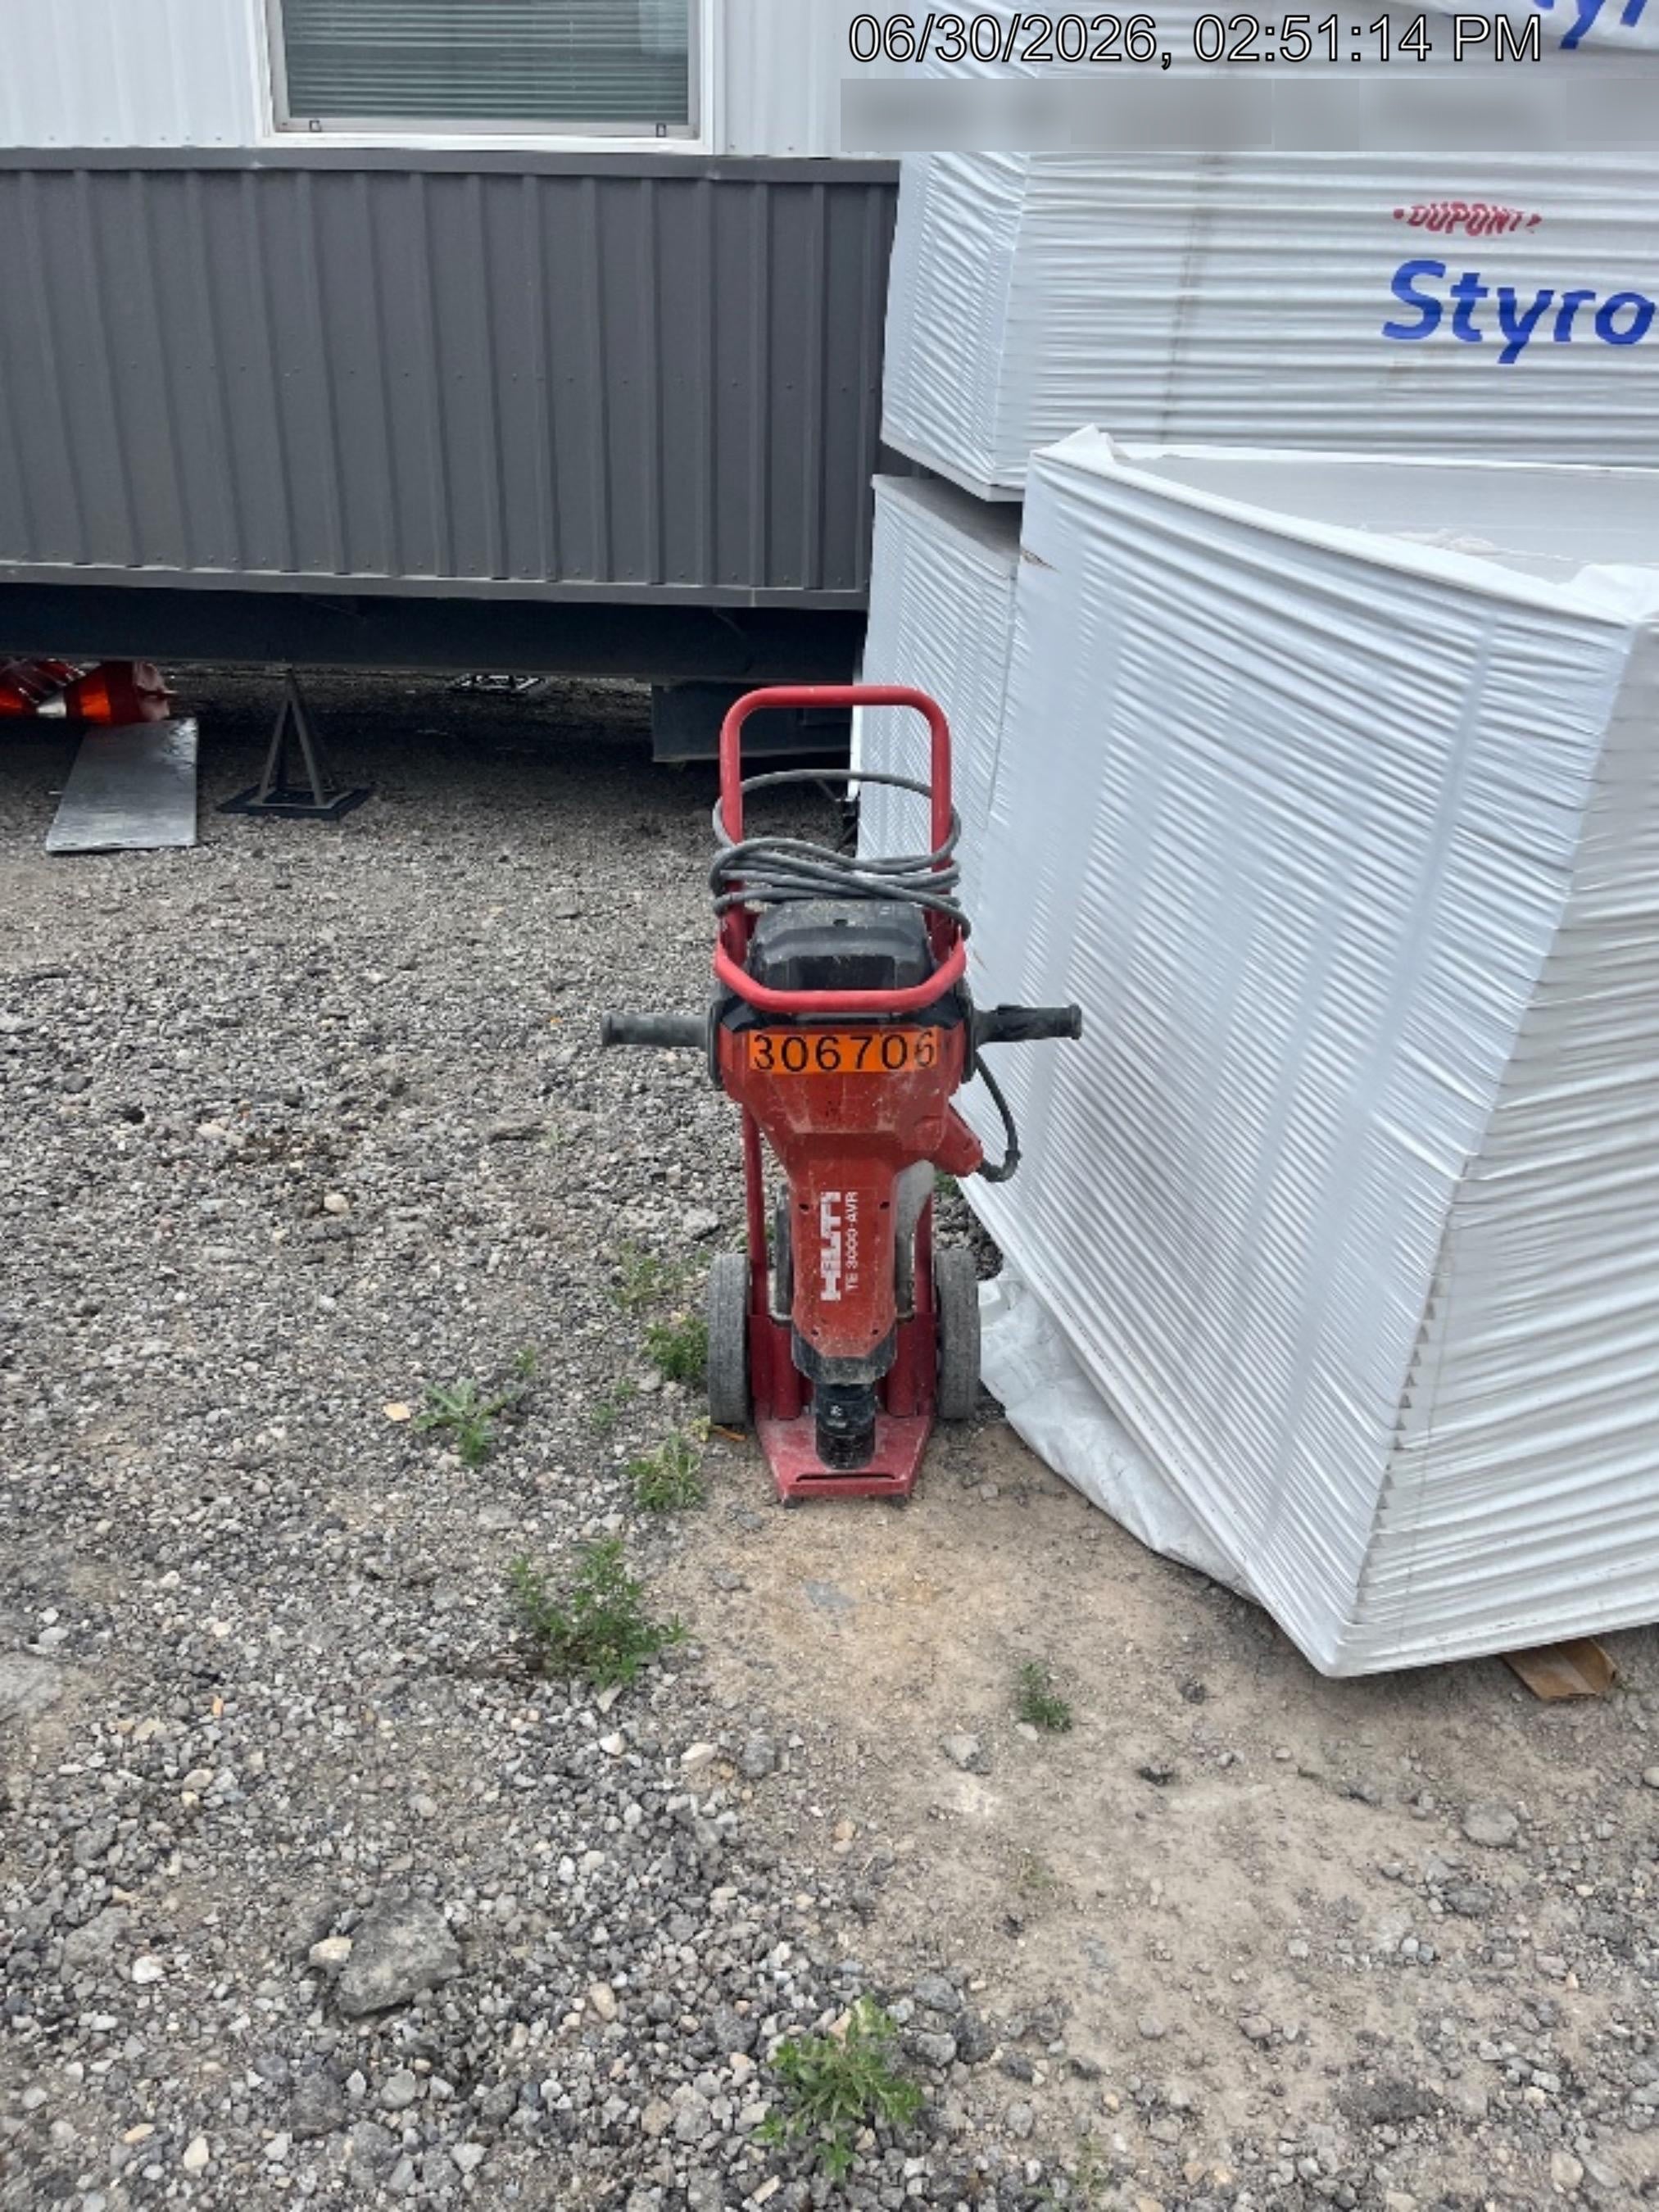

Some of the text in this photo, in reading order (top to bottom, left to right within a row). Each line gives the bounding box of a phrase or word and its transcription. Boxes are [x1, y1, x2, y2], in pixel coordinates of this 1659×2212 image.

[1382, 260, 1657, 364] Styro
[754, 1028, 935, 1072] 306706
[820, 1191, 841, 1301] HILTI
[845, 1272, 859, 1292] TE
